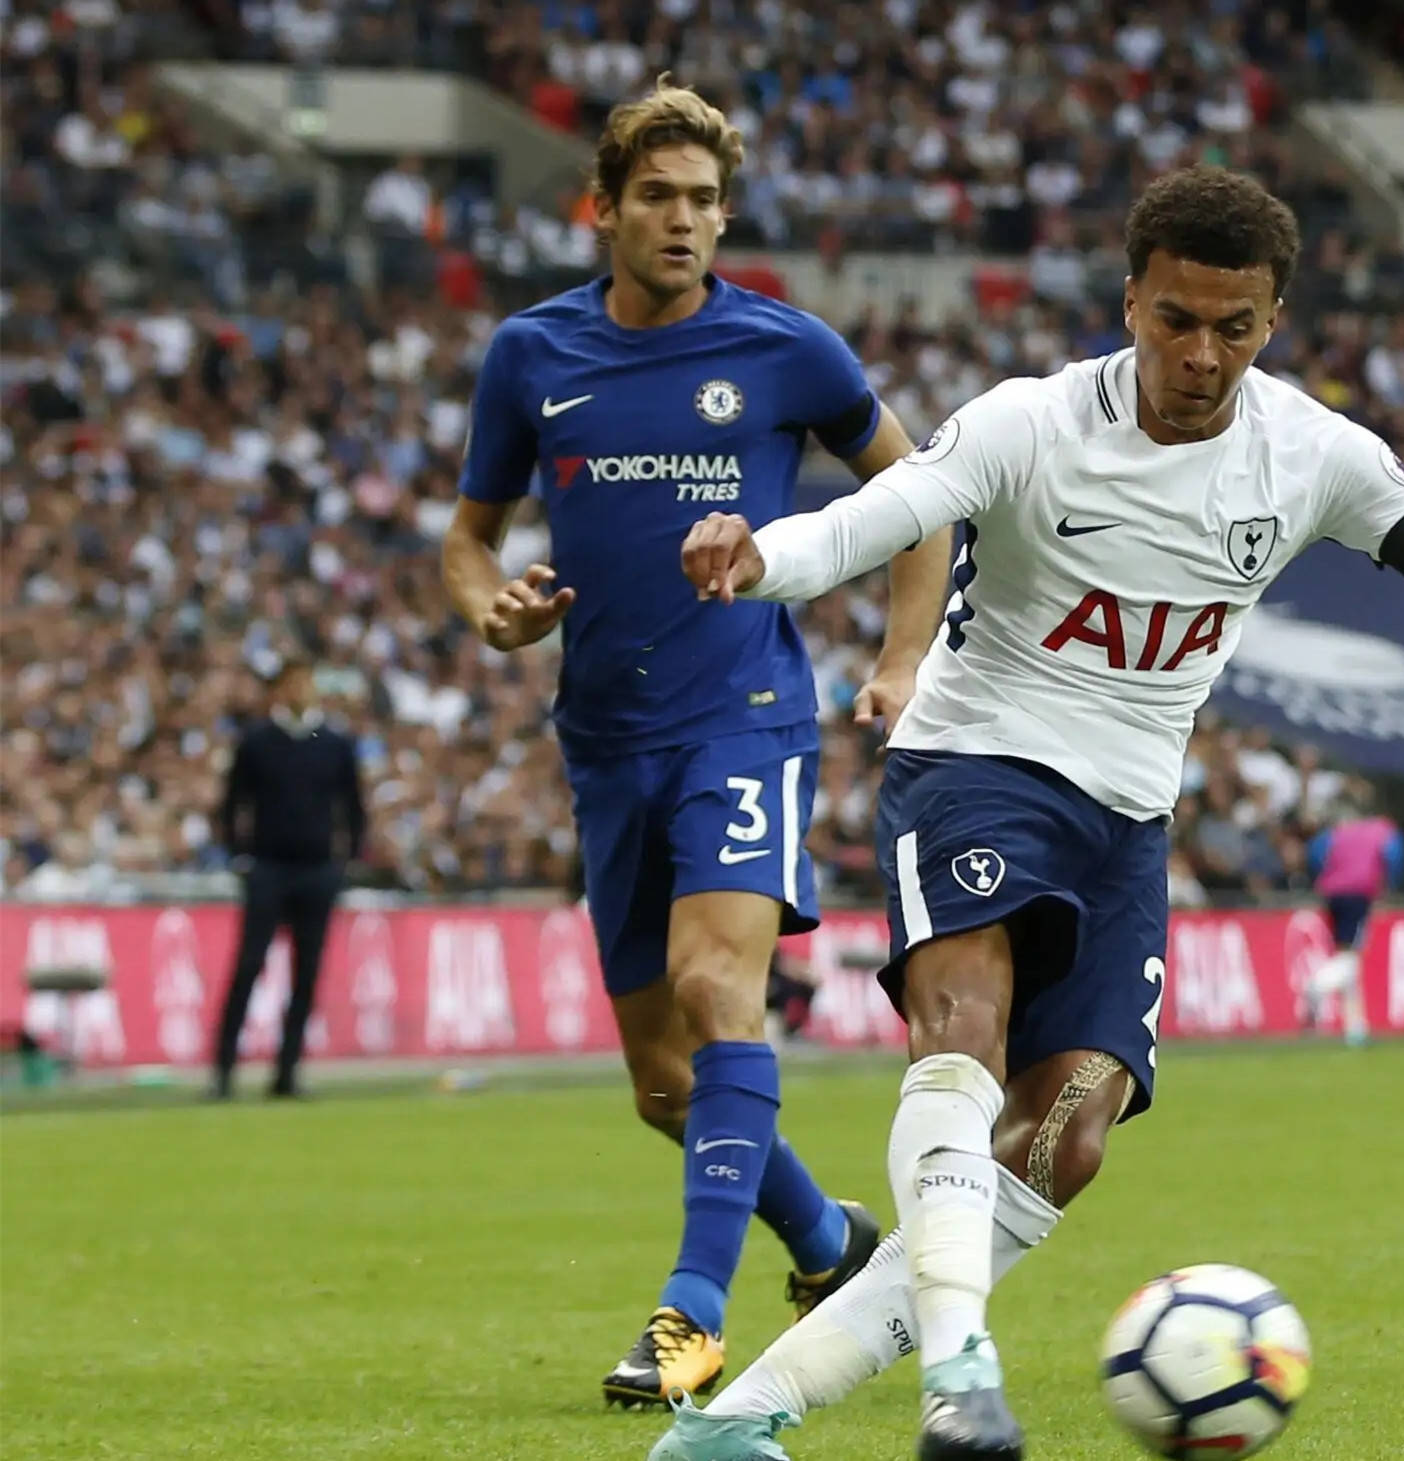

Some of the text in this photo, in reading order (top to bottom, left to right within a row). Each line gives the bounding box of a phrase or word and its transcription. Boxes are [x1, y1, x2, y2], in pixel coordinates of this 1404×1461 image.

[586, 454, 741, 483] YOKOHAMA
[676, 482, 740, 501] TYRES
[1040, 588, 1229, 671] AIA
[725, 776, 768, 842] 3
[705, 1164, 741, 1181] CFC
[886, 1318, 915, 1357] SPU
